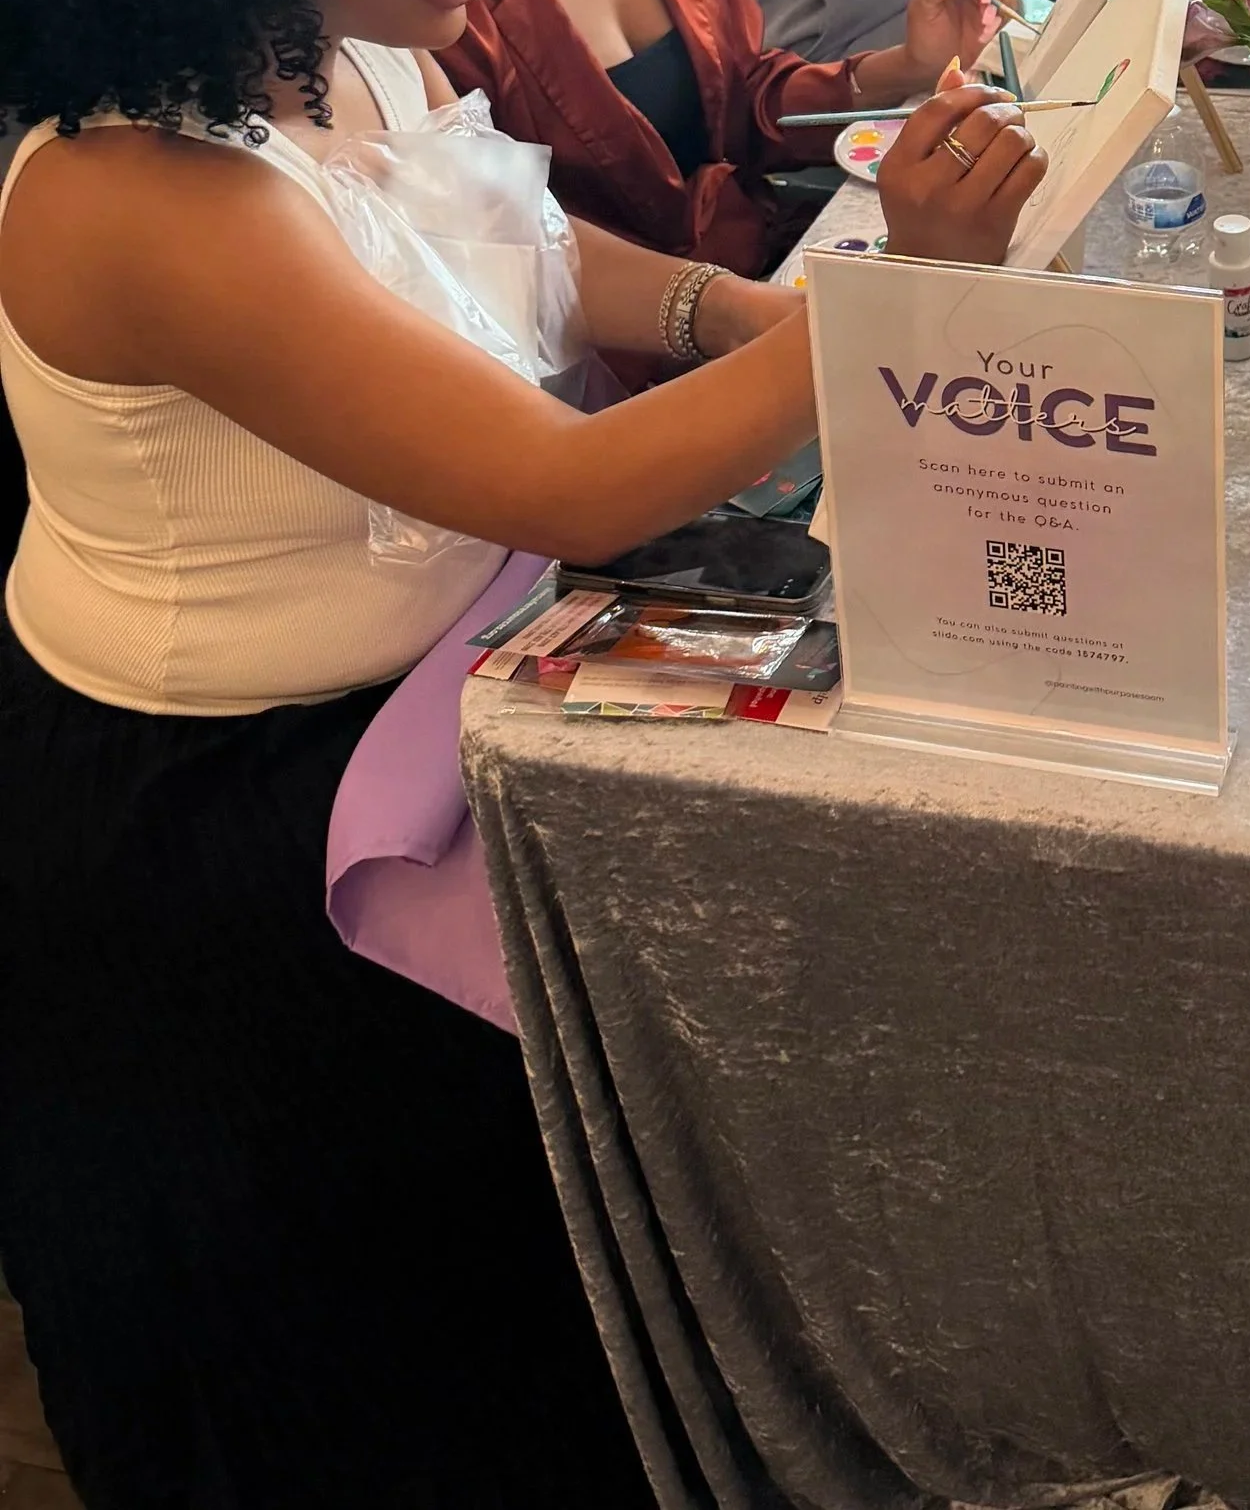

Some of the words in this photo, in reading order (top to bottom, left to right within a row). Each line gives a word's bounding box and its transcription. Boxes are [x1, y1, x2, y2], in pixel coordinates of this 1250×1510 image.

[976, 349, 1054, 380] Your
[878, 366, 1158, 457] VOICE
[900, 384, 1137, 436] matters
[919, 458, 960, 473] Scan
[968, 464, 1006, 480] here
[1014, 471, 1030, 482] to
[1038, 475, 1095, 491] submit
[1103, 484, 1125, 495] an
[933, 483, 1029, 503] anonymous
[1037, 496, 1112, 515] question
[967, 506, 992, 520] for
[1000, 511, 1026, 524] the
[1034, 514, 1080, 531] Q&A.
[932, 629, 985, 644] slido.com
[989, 638, 1019, 651] using
[1023, 642, 1041, 652] the
[1045, 646, 1073, 657] code
[936, 616, 956, 627] You
[959, 620, 981, 630] can
[984, 623, 1007, 634] also
[1011, 627, 1049, 640] submit
[1053, 633, 1108, 648] questions
[1112, 641, 1124, 650] at
